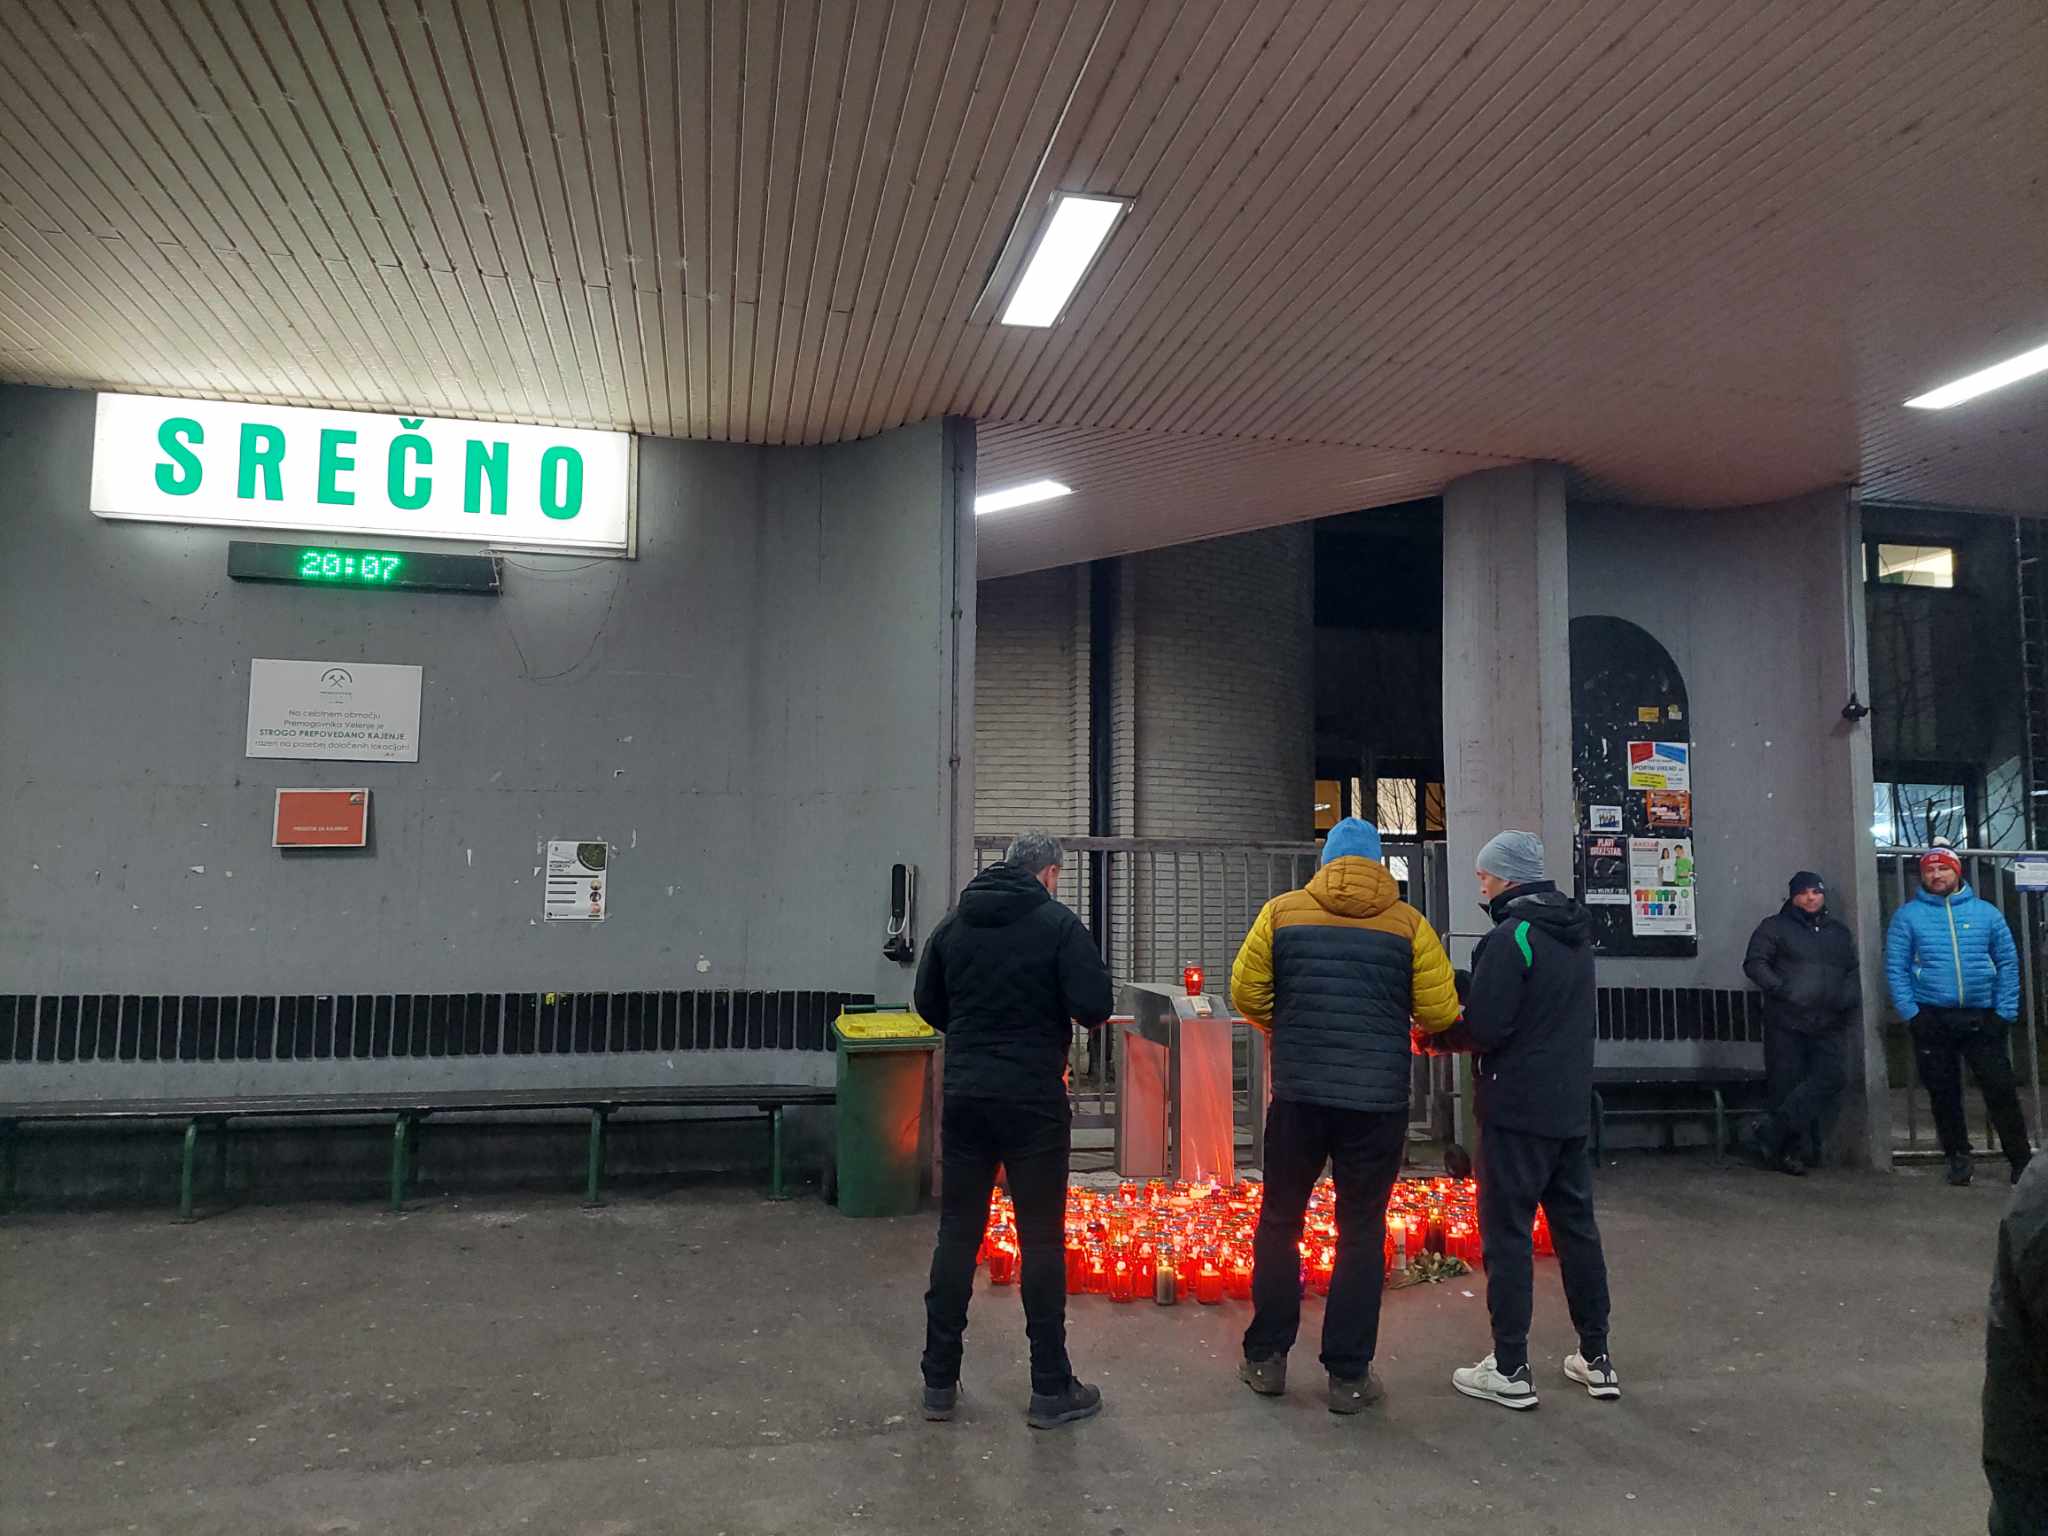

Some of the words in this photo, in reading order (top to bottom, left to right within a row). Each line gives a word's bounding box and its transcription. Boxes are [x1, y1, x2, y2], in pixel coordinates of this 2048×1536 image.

[155, 417, 584, 520] SREČNO
[302, 551, 401, 581] 20:07
[259, 729, 296, 737] STROGO
[299, 730, 366, 738] PREPOVEDANO
